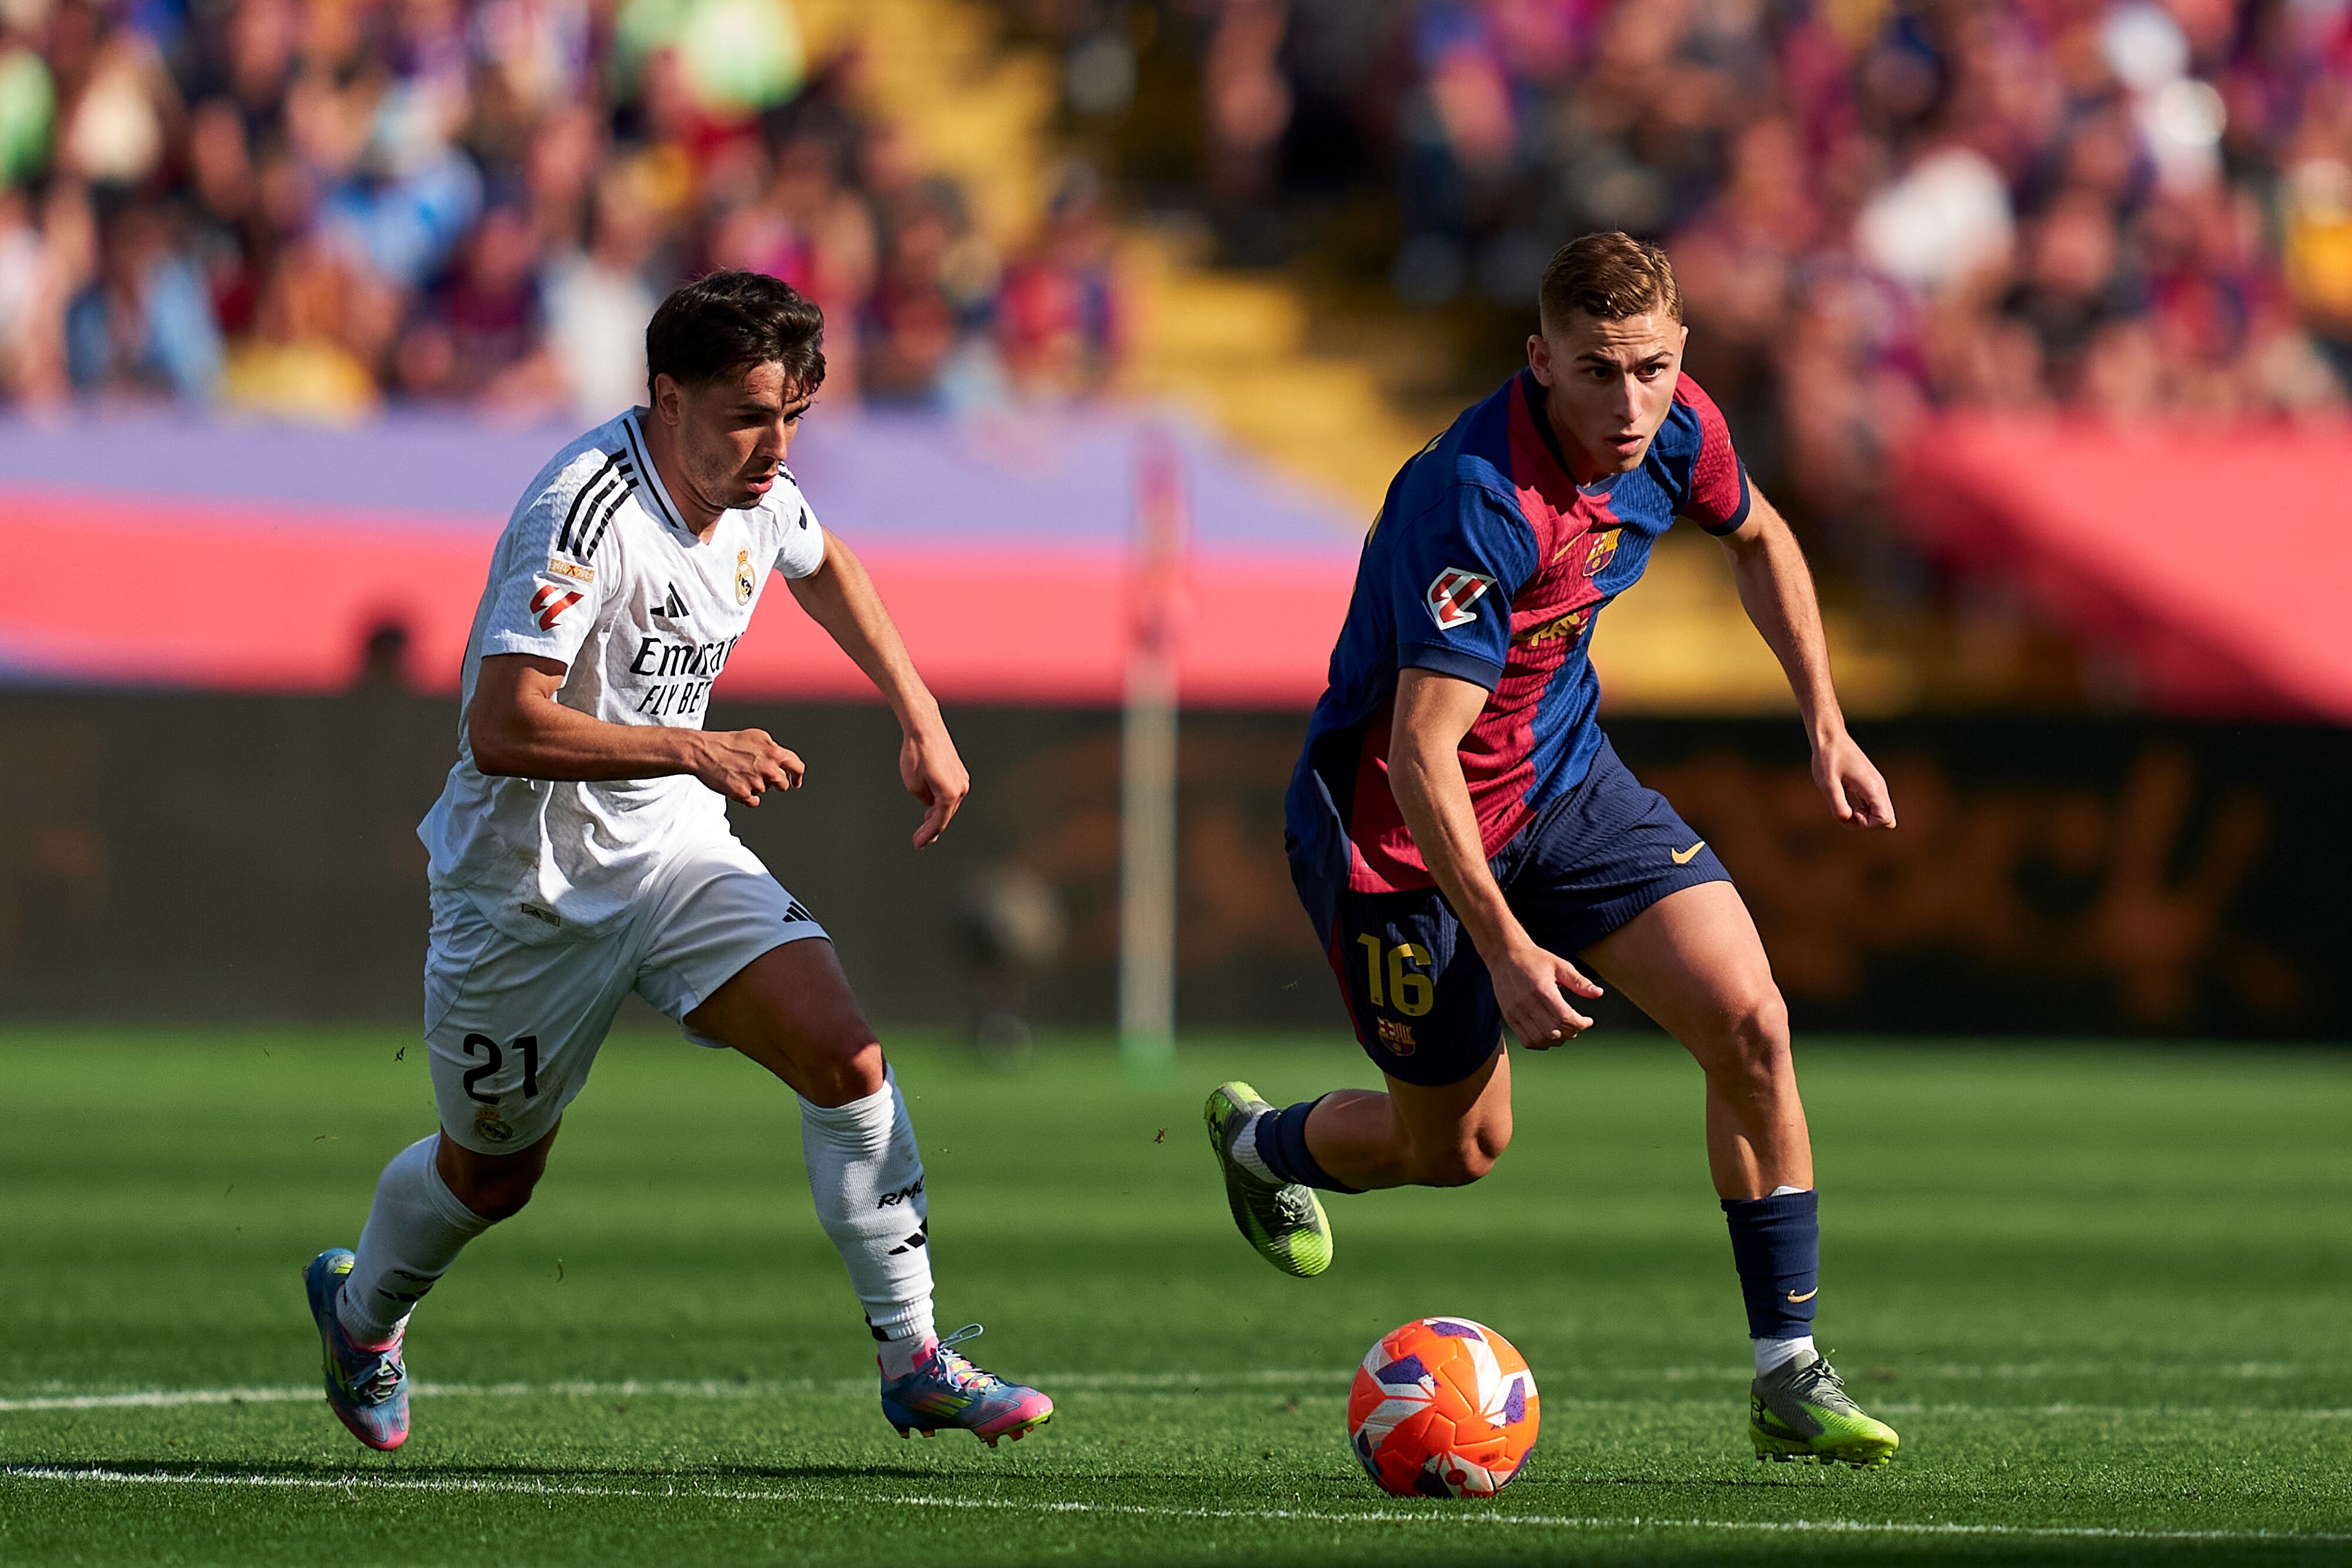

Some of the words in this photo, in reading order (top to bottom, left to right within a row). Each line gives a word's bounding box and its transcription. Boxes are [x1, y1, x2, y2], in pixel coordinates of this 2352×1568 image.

[629, 631, 744, 677] Emirat
[636, 684, 679, 716] FLY
[1357, 932, 1434, 1017] 16
[463, 1032, 539, 1105] 21
